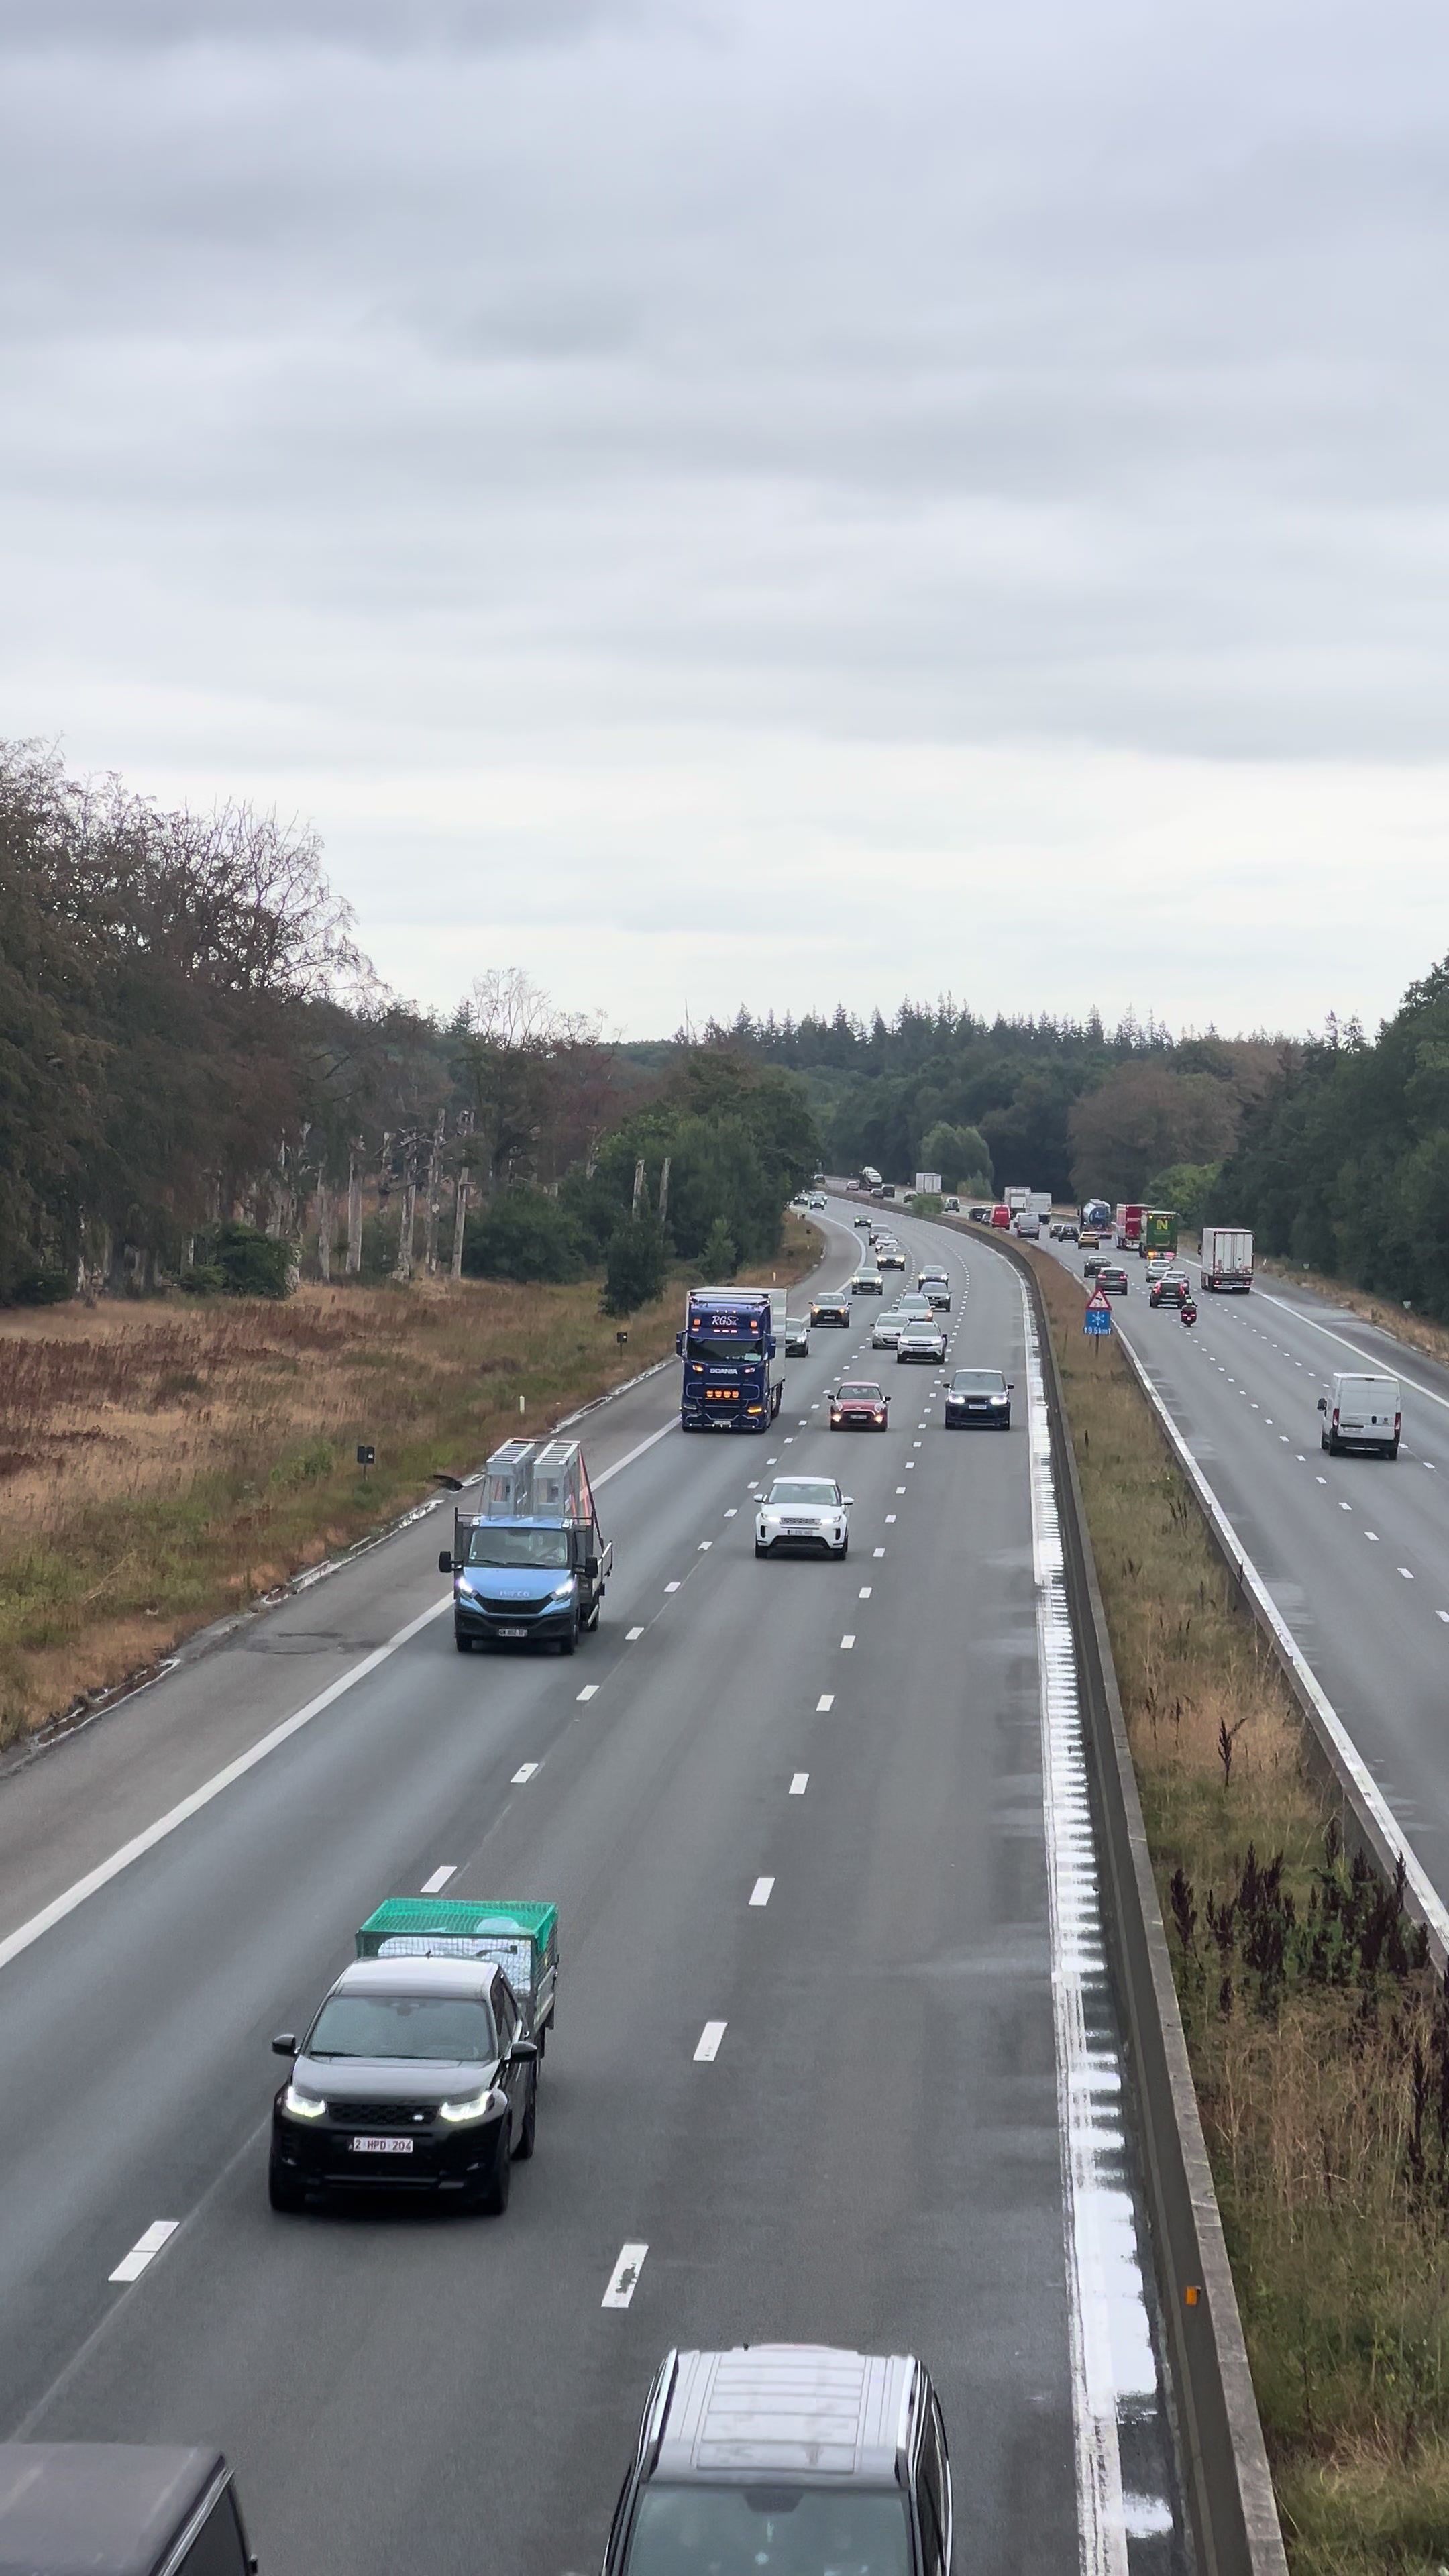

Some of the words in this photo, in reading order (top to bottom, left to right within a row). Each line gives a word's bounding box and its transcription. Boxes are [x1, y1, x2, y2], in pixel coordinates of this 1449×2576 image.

[712, 1315, 732, 1326] RGS
[354, 2139, 361, 2150] 2
[367, 2140, 386, 2151] HPD
